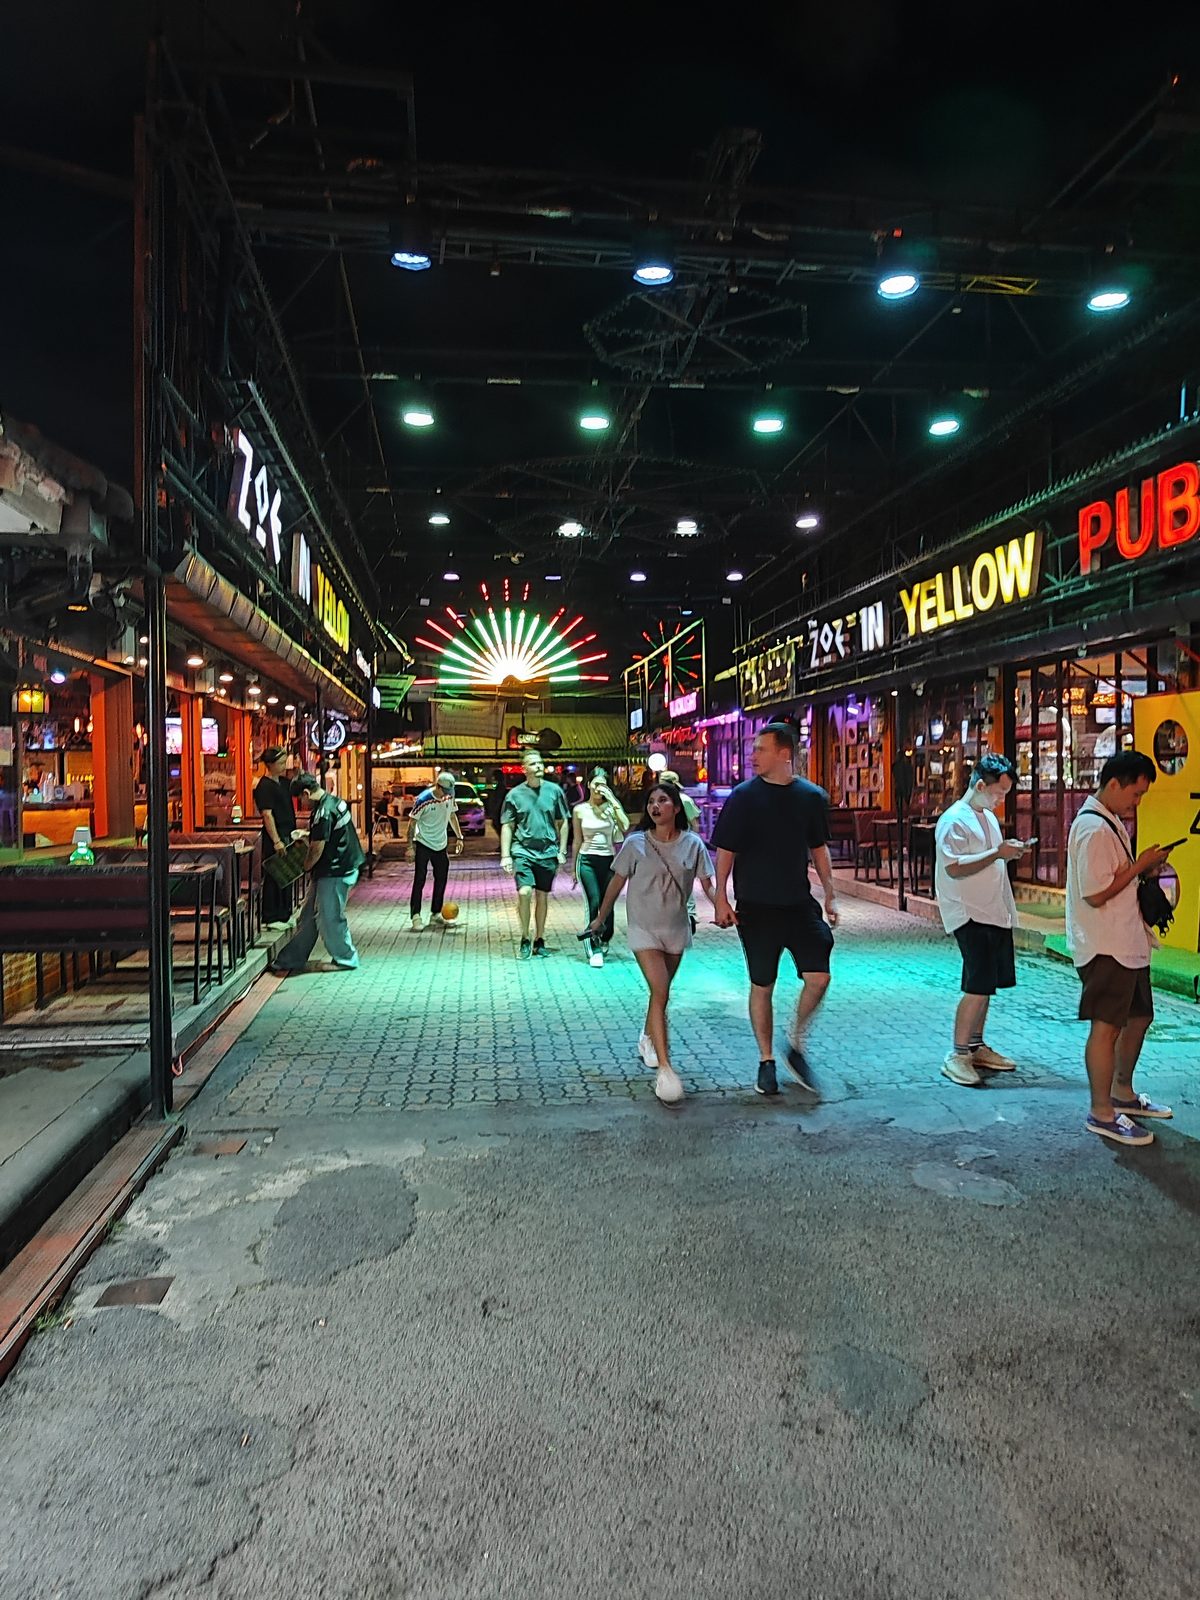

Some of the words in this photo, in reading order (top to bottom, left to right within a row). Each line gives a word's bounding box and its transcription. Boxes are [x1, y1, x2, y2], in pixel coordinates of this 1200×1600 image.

[860, 600, 884, 652] IN
[900, 532, 1036, 637] YELLOW
[1079, 462, 1200, 576] PUB
